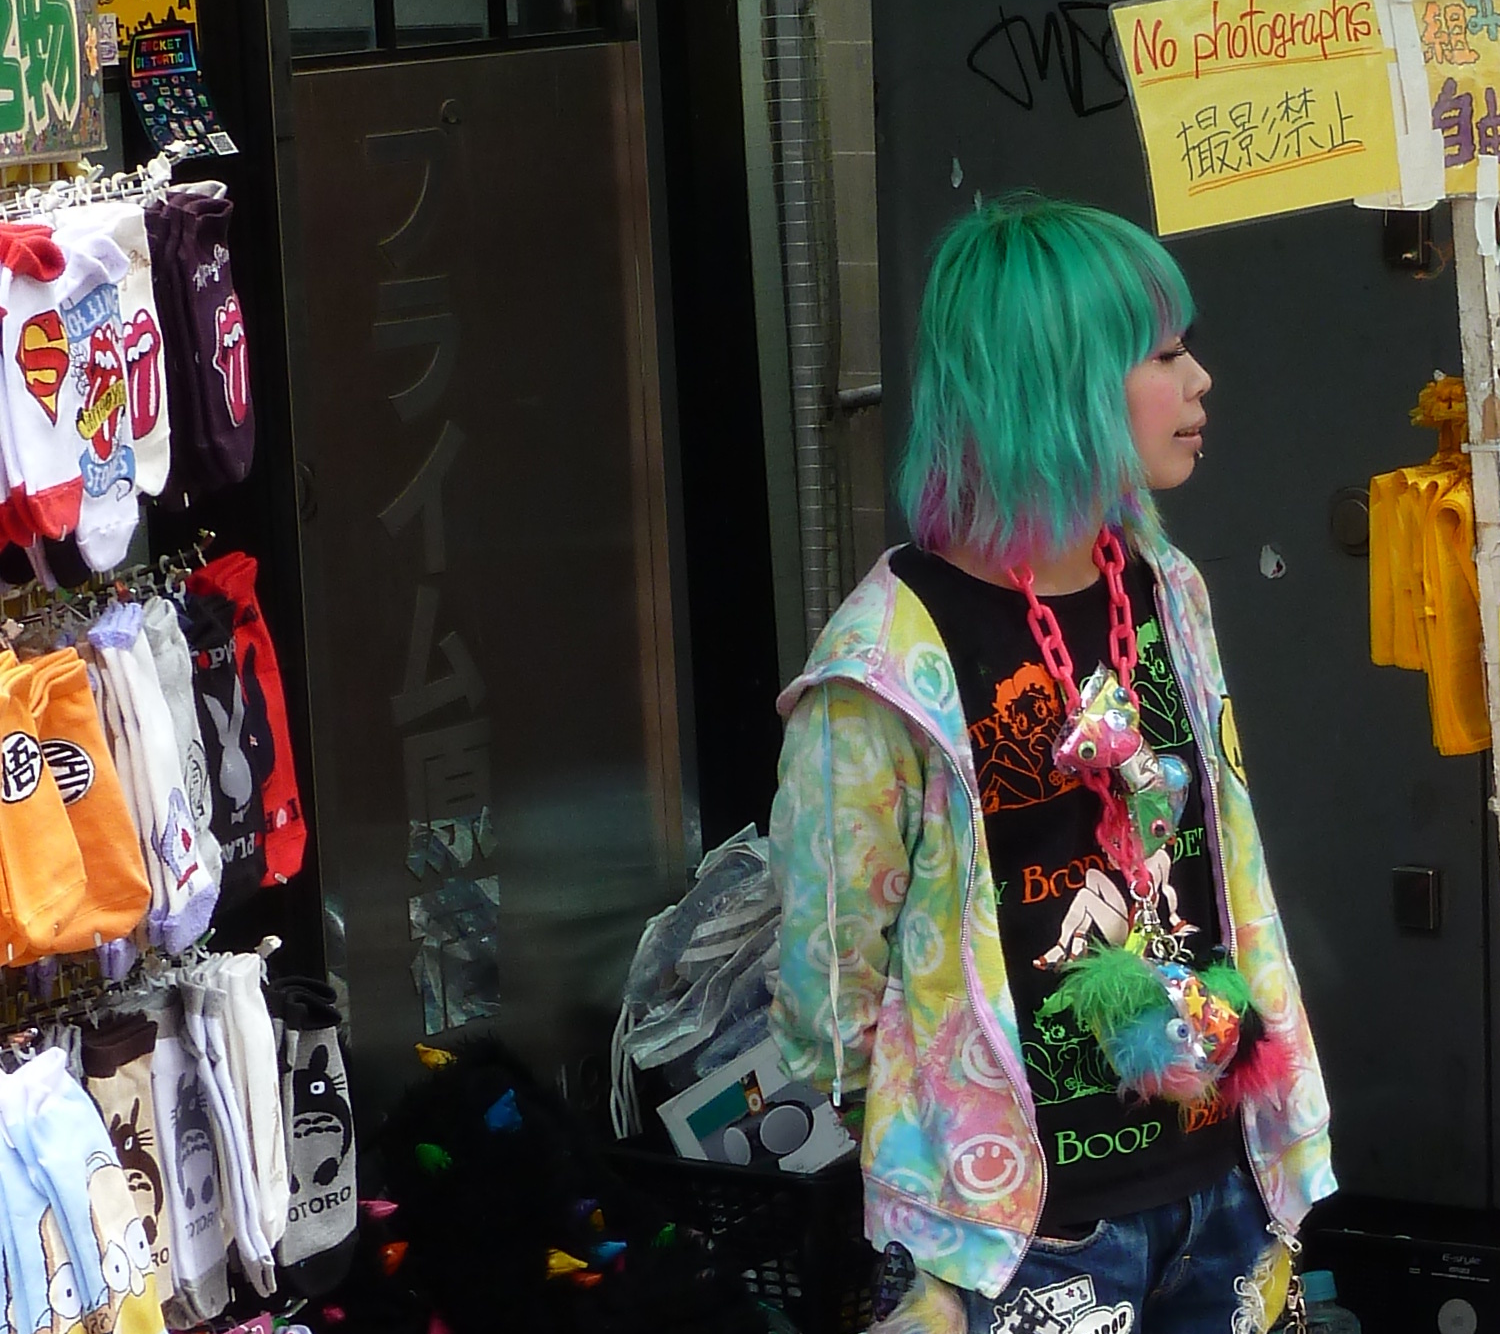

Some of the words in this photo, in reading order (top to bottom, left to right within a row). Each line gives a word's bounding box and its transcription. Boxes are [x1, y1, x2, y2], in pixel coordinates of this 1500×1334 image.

[1132, 17, 1178, 75] No
[1176, 87, 1365, 183] 撮影禁止
[1055, 1120, 1162, 1166] BOOP
